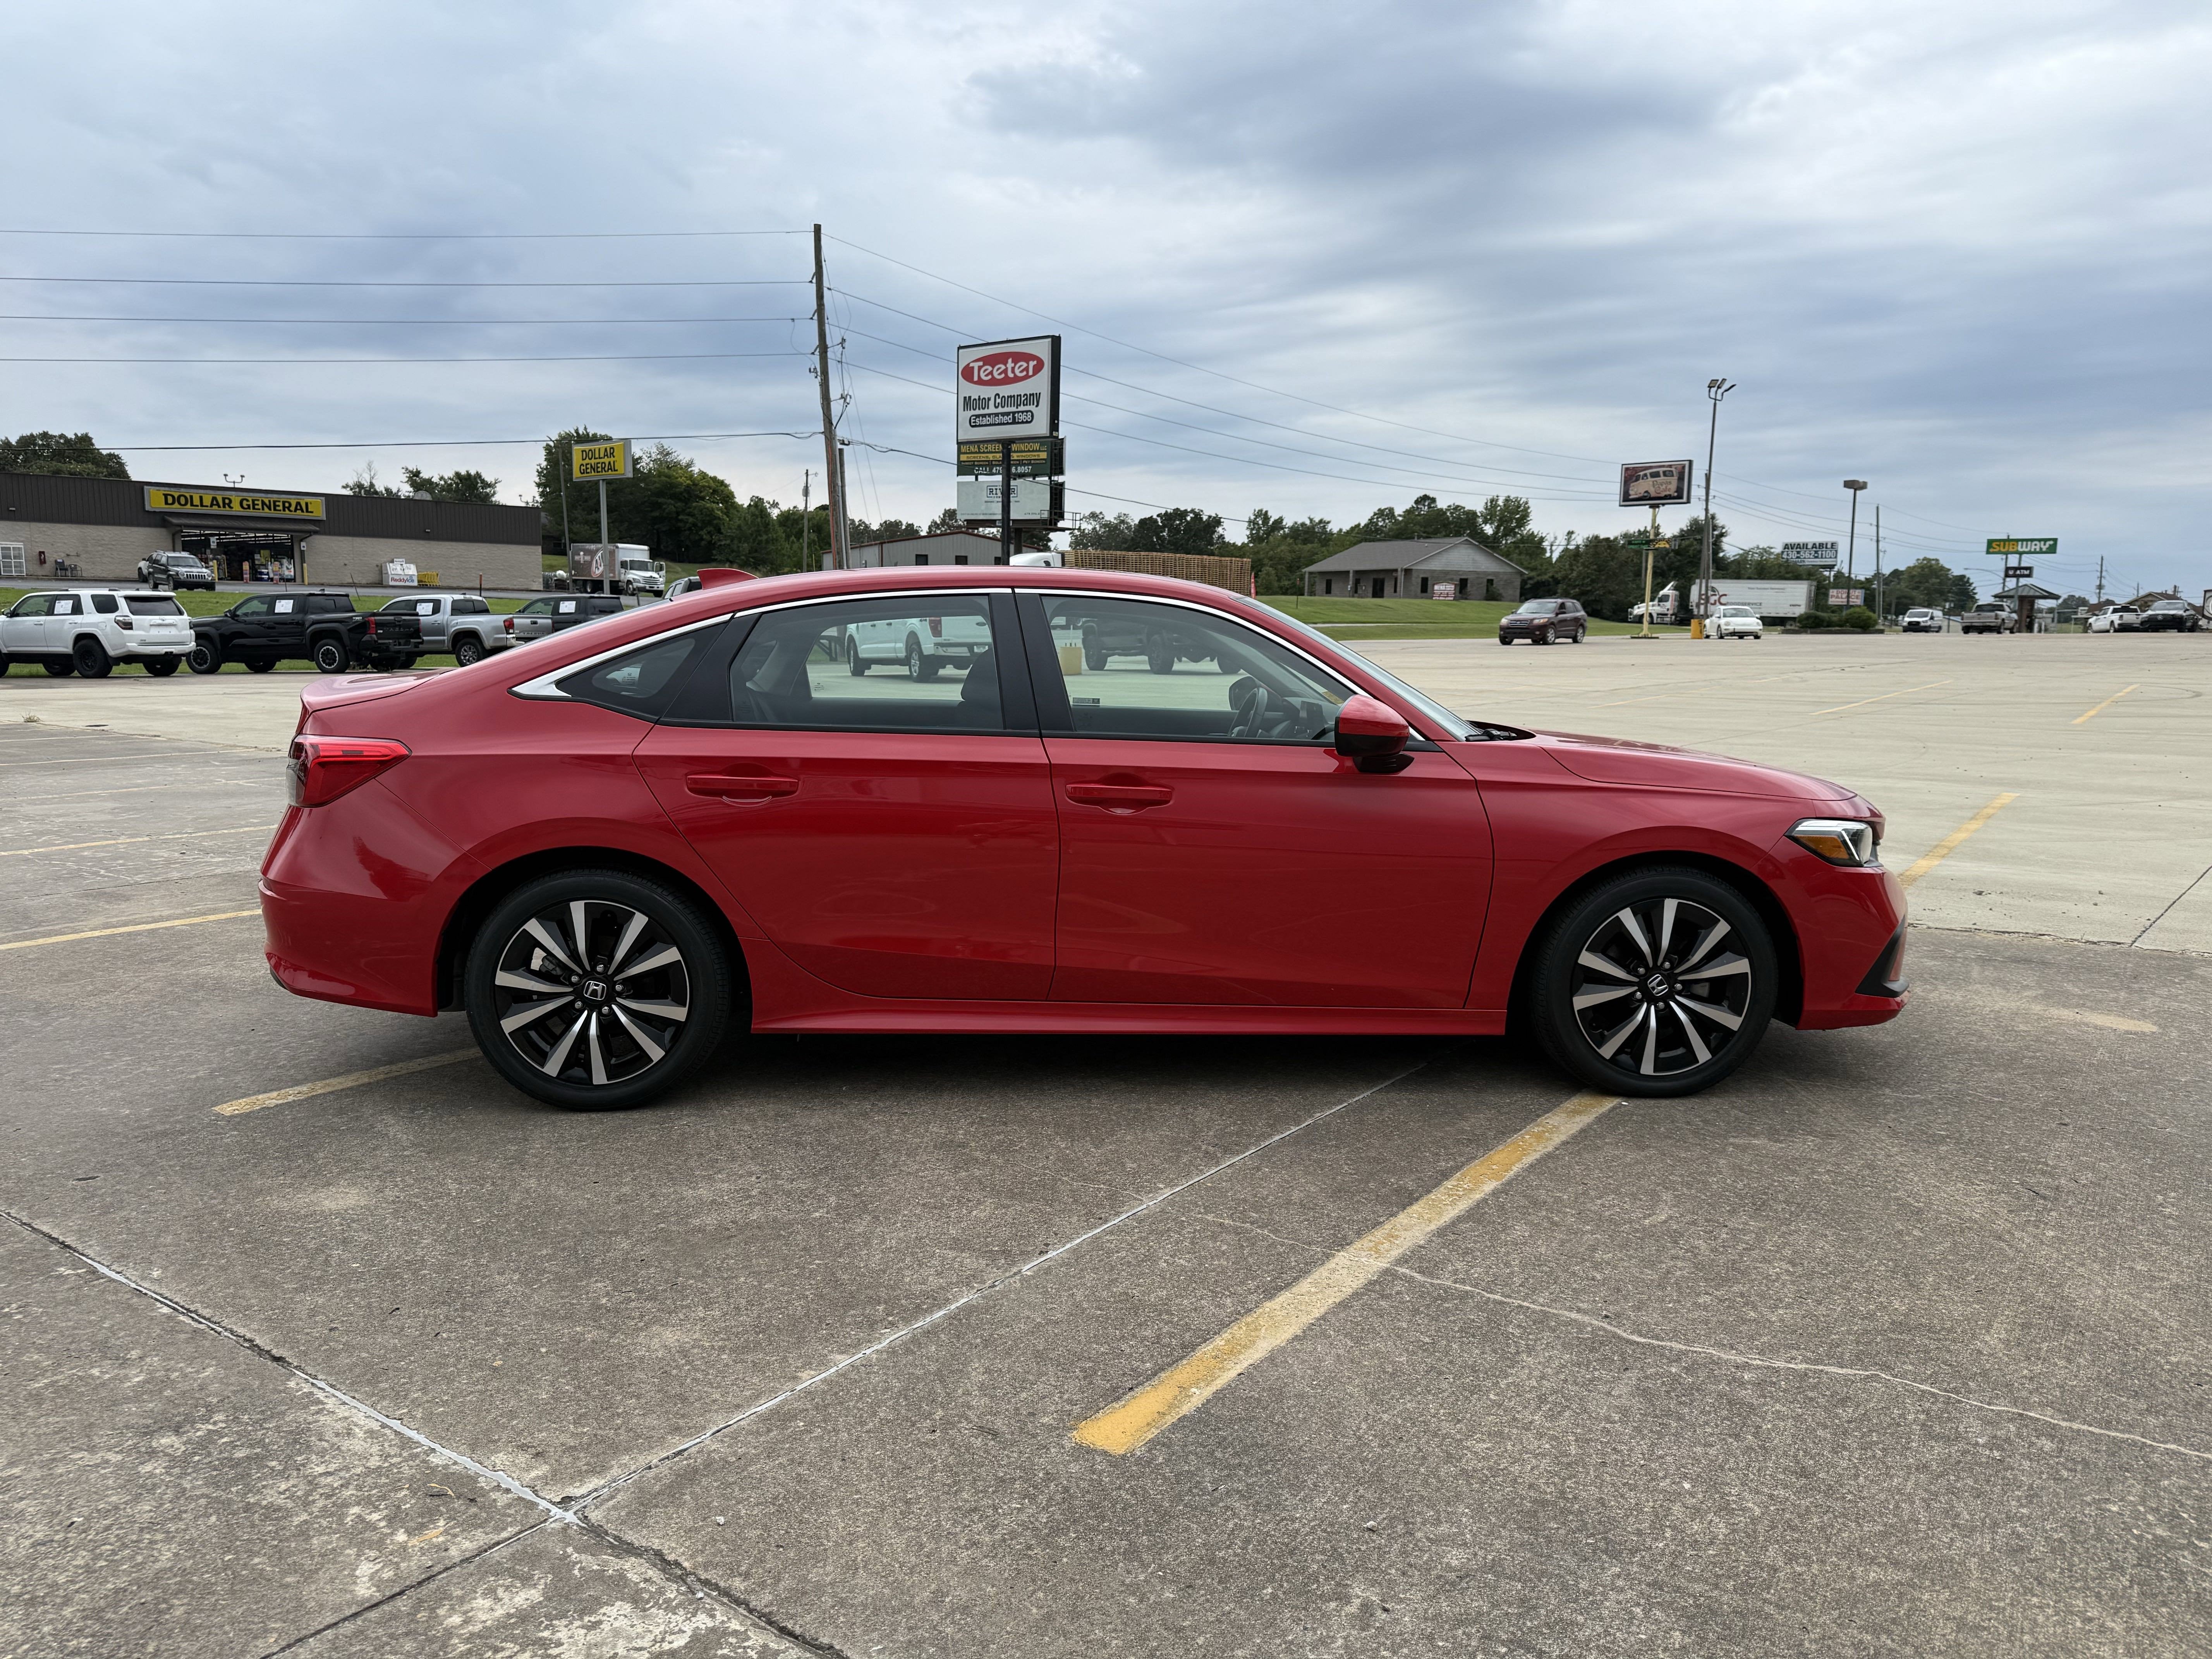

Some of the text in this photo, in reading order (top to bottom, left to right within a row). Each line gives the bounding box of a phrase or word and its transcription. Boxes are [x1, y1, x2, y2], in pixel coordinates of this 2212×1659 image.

[969, 357, 1037, 381] Teeter
[963, 392, 1041, 412] Motor Company
[971, 412, 1032, 426] Established 1968
[581, 447, 615, 461] DOLLAR
[1011, 443, 1040, 451] WINDOW
[579, 460, 618, 475] GENERAL
[163, 493, 314, 514] DOLLAR GENERAL
[1989, 541, 2054, 552] SUBWAY
[1782, 551, 1836, 559] 430-562-1100
